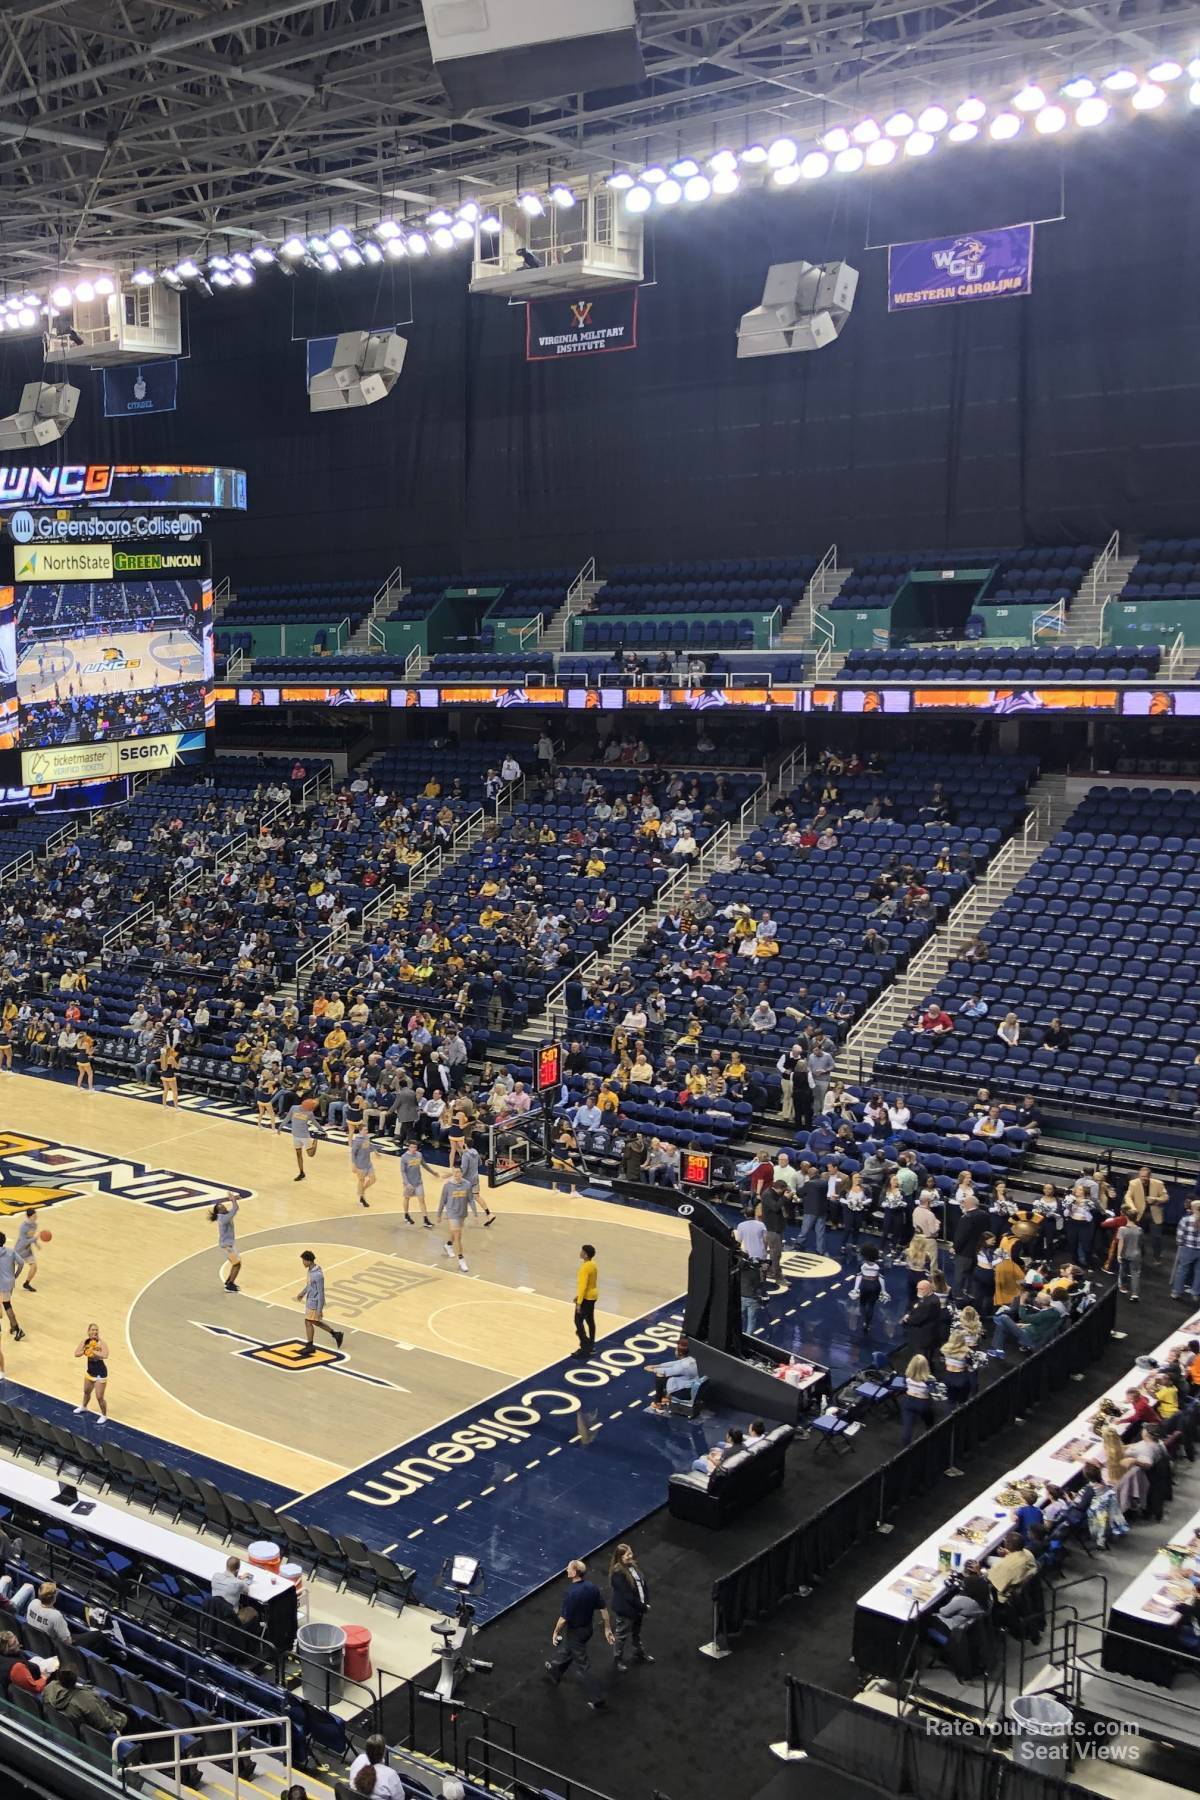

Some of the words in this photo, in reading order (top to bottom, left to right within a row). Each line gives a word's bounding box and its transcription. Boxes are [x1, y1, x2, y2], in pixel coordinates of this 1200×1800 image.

[894, 287, 955, 304] WESTERN
[957, 276, 1022, 296] CAROLINA
[538, 333, 579, 346] VIRGINIA
[580, 327, 624, 341] MILITARY
[556, 340, 605, 354] INSTITUTE
[38, 515, 132, 537] Greensboro
[135, 515, 202, 535] Coliseum
[43, 554, 110, 571] NorthState
[114, 552, 161, 570] GREEN
[161, 554, 202, 568] LINCOLN
[82, 657, 141, 674] UNCG
[53, 750, 106, 767] ticketmaster
[120, 743, 169, 760] SEGRA
[347, 1389, 583, 1507] Coliseum
